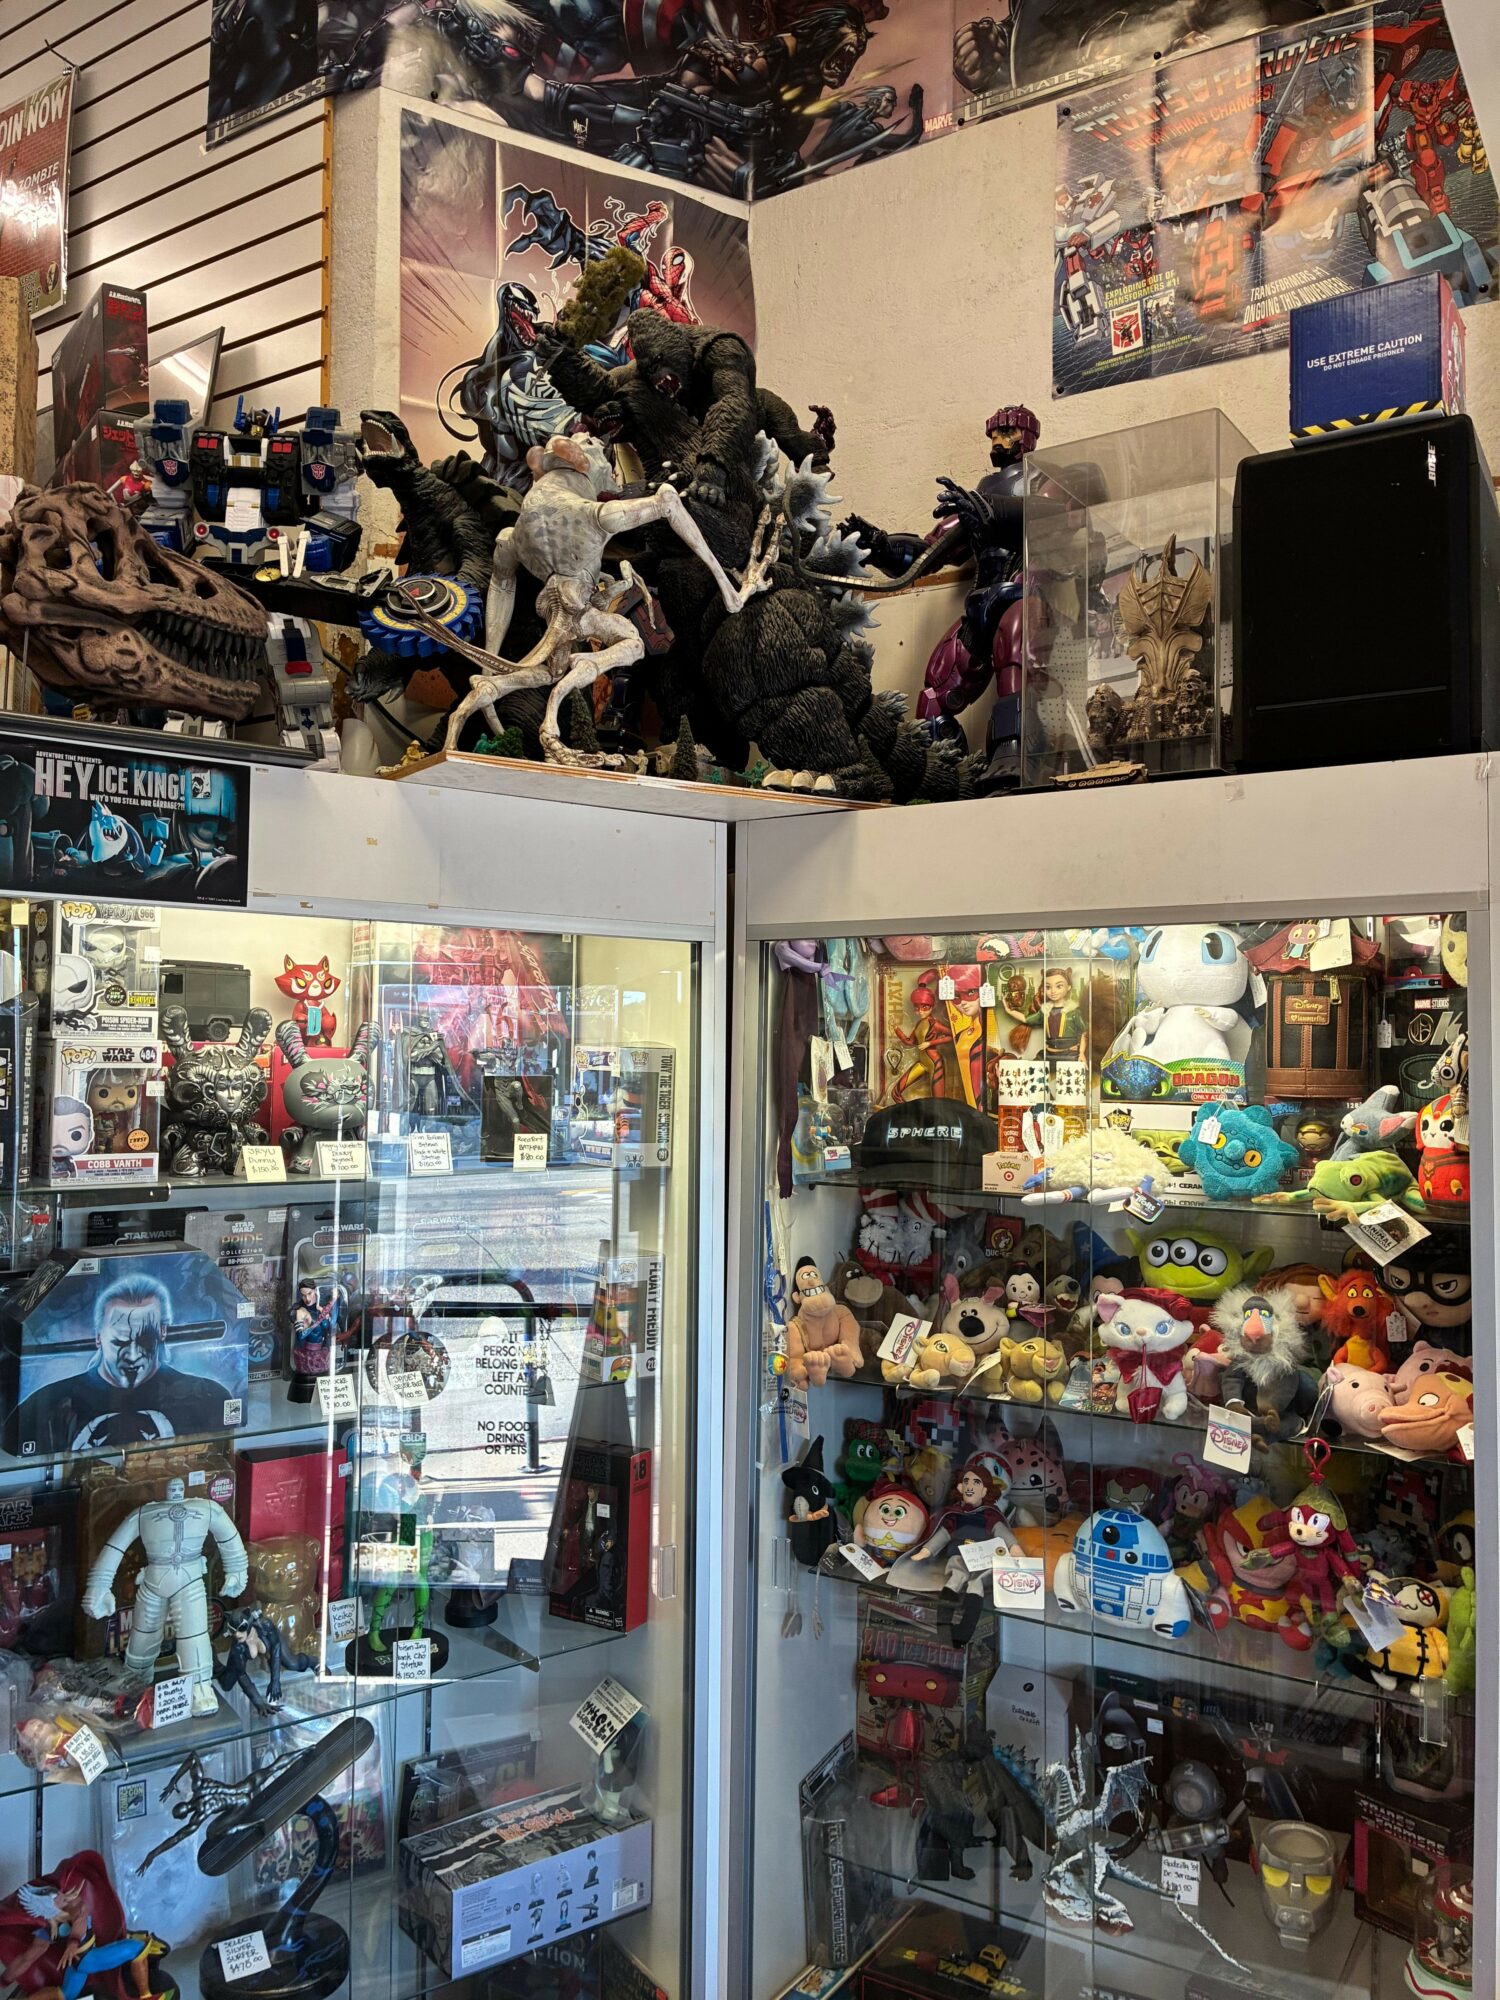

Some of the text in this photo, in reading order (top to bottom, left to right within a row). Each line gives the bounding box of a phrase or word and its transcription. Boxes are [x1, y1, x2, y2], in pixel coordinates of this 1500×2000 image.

[27, 85, 67, 137] NOW
[925, 113, 952, 133] MARVE
[18, 162, 60, 191] ZOMBIE
[1105, 269, 1175, 300] EXPLODING OUT OF
[1250, 270, 1316, 302] TRANSFORMERS
[1104, 283, 1165, 309] TRANSFORMERS
[1243, 276, 1354, 324] ONGOING THIS NOVEMBER!
[1306, 333, 1423, 369] USE EXTREME CAUTION
[1323, 347, 1405, 372] DO NOT ENGAGE PRISONER
[1427, 440, 1437, 487] BOSE
[36, 750, 64, 760] ADVENTURE
[65, 753, 76, 761] TIME
[34, 757, 186, 801] HEY ICE KING!
[90, 793, 109, 803] WHY'D
[110, 795, 122, 804] YOU
[122, 797, 140, 806] STEAL
[140, 799, 152, 807] OUR
[62, 902, 96, 919] POP!
[1293, 1000, 1324, 1012] Disney
[120, 1017, 149, 1025] SPIDER-MAN
[1391, 1011, 1465, 1046] LOK
[62, 1048, 96, 1064] POP!
[140, 1051, 156, 1060] 484
[1172, 1073, 1240, 1087] DRAGON
[21, 1026, 33, 1154] DR. BRITT BAKER
[656, 1055, 673, 1143] TONY THE TIGER SURFING
[888, 1126, 962, 1139] SPHERE
[88, 1159, 142, 1168] COBB VANTH
[231, 1226, 255, 1234] WARS
[340, 1223, 364, 1232] WARS
[124, 1230, 177, 1241] STAR WARS
[1367, 1224, 1392, 1247] ANIMAL
[492, 1371, 515, 1382] LEFT
[484, 1384, 530, 1396] COUNTE
[477, 1421, 533, 1432] NO FOOD
[400, 1433, 426, 1443] CBLDF
[486, 1433, 526, 1443] DRINKS
[484, 1444, 528, 1455] OR PETS
[633, 1459, 648, 1481] 18
[332, 1612, 352, 1622] Keiko
[863, 1629, 966, 1667] BAD ROBOT
[1183, 1763, 1195, 1776] 2
[226, 1942, 255, 1957] SILVER
